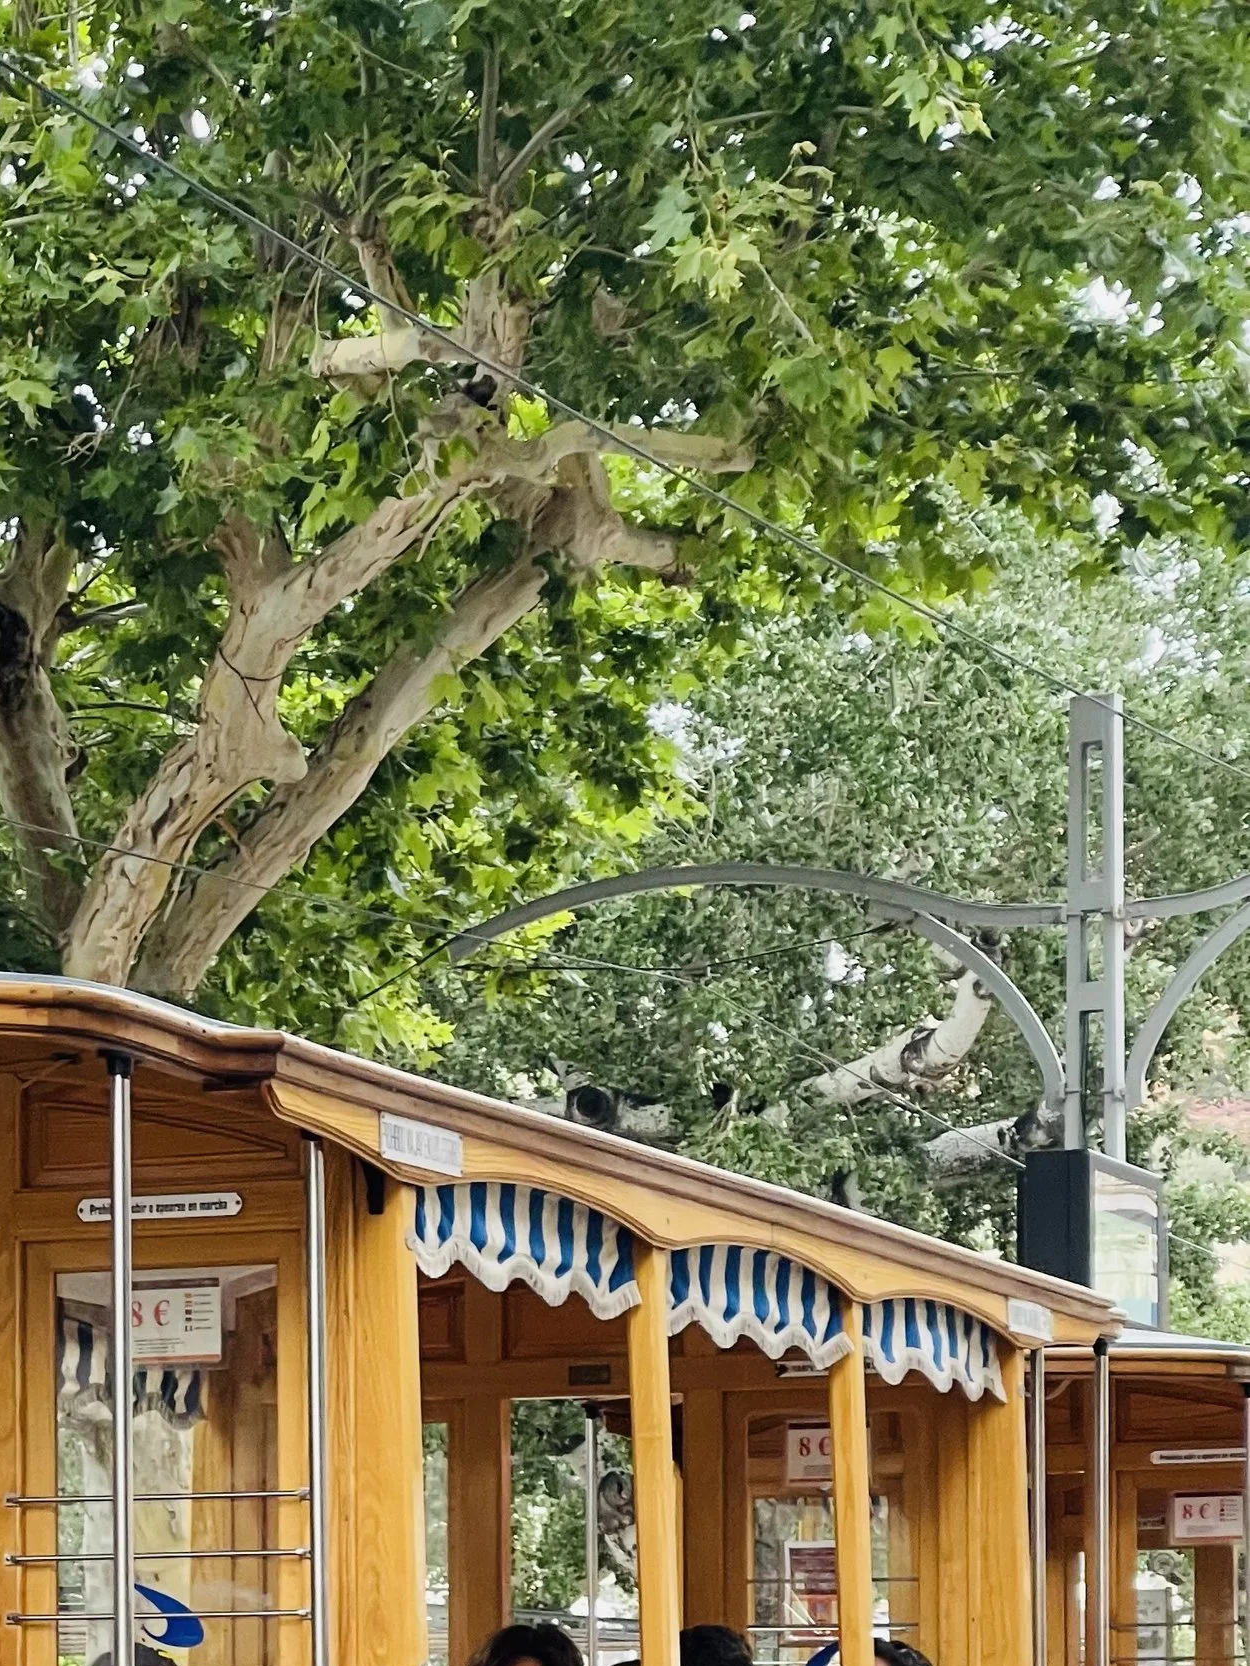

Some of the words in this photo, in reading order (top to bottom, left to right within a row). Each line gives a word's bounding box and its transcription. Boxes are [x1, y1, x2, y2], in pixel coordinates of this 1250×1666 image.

[131, 1300, 143, 1327] 8
[153, 1300, 170, 1326] €
[798, 1436, 811, 1456] 8
[1182, 1503, 1193, 1520] 8
